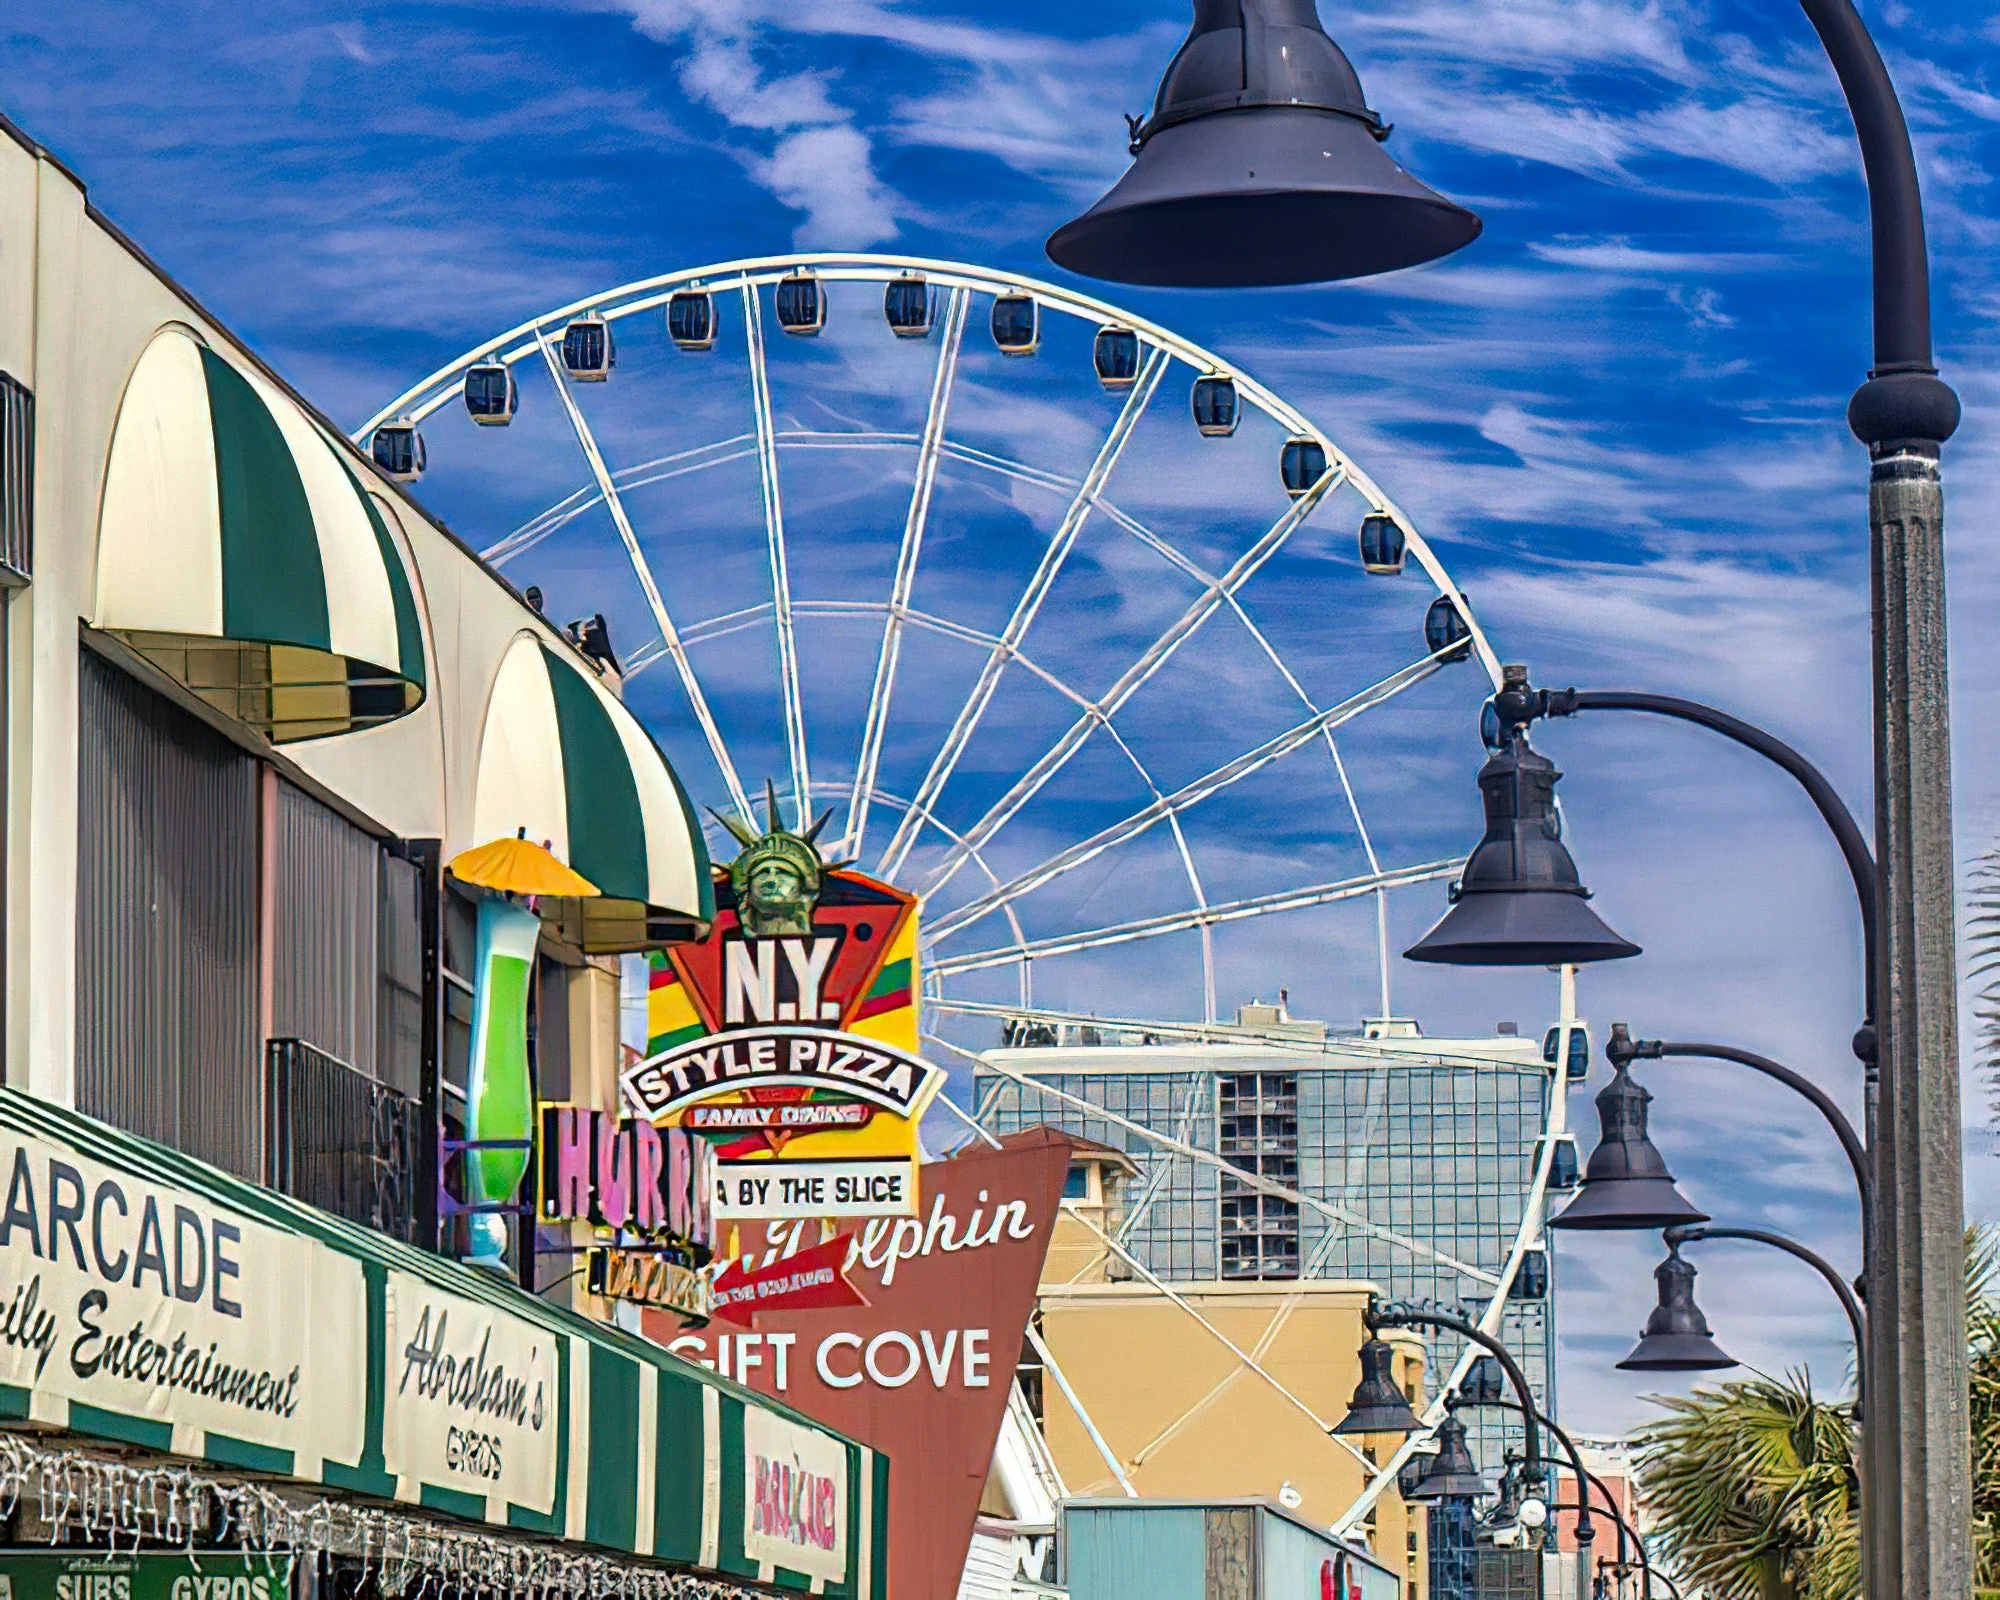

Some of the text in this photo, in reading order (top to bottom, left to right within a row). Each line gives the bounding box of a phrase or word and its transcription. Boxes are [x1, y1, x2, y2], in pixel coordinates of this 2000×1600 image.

[725, 937, 840, 1024] N.Y.
[637, 1039, 914, 1102] STYLE PIZZA
[0, 1146, 242, 1319] ARCADE
[739, 1178, 770, 1206] BY
[779, 1177, 825, 1204] THE
[835, 1174, 902, 1203] SLICE
[842, 1191, 1034, 1286] lphin
[0, 1274, 300, 1418] ily Entertainment
[816, 1329, 990, 1388] COVE
